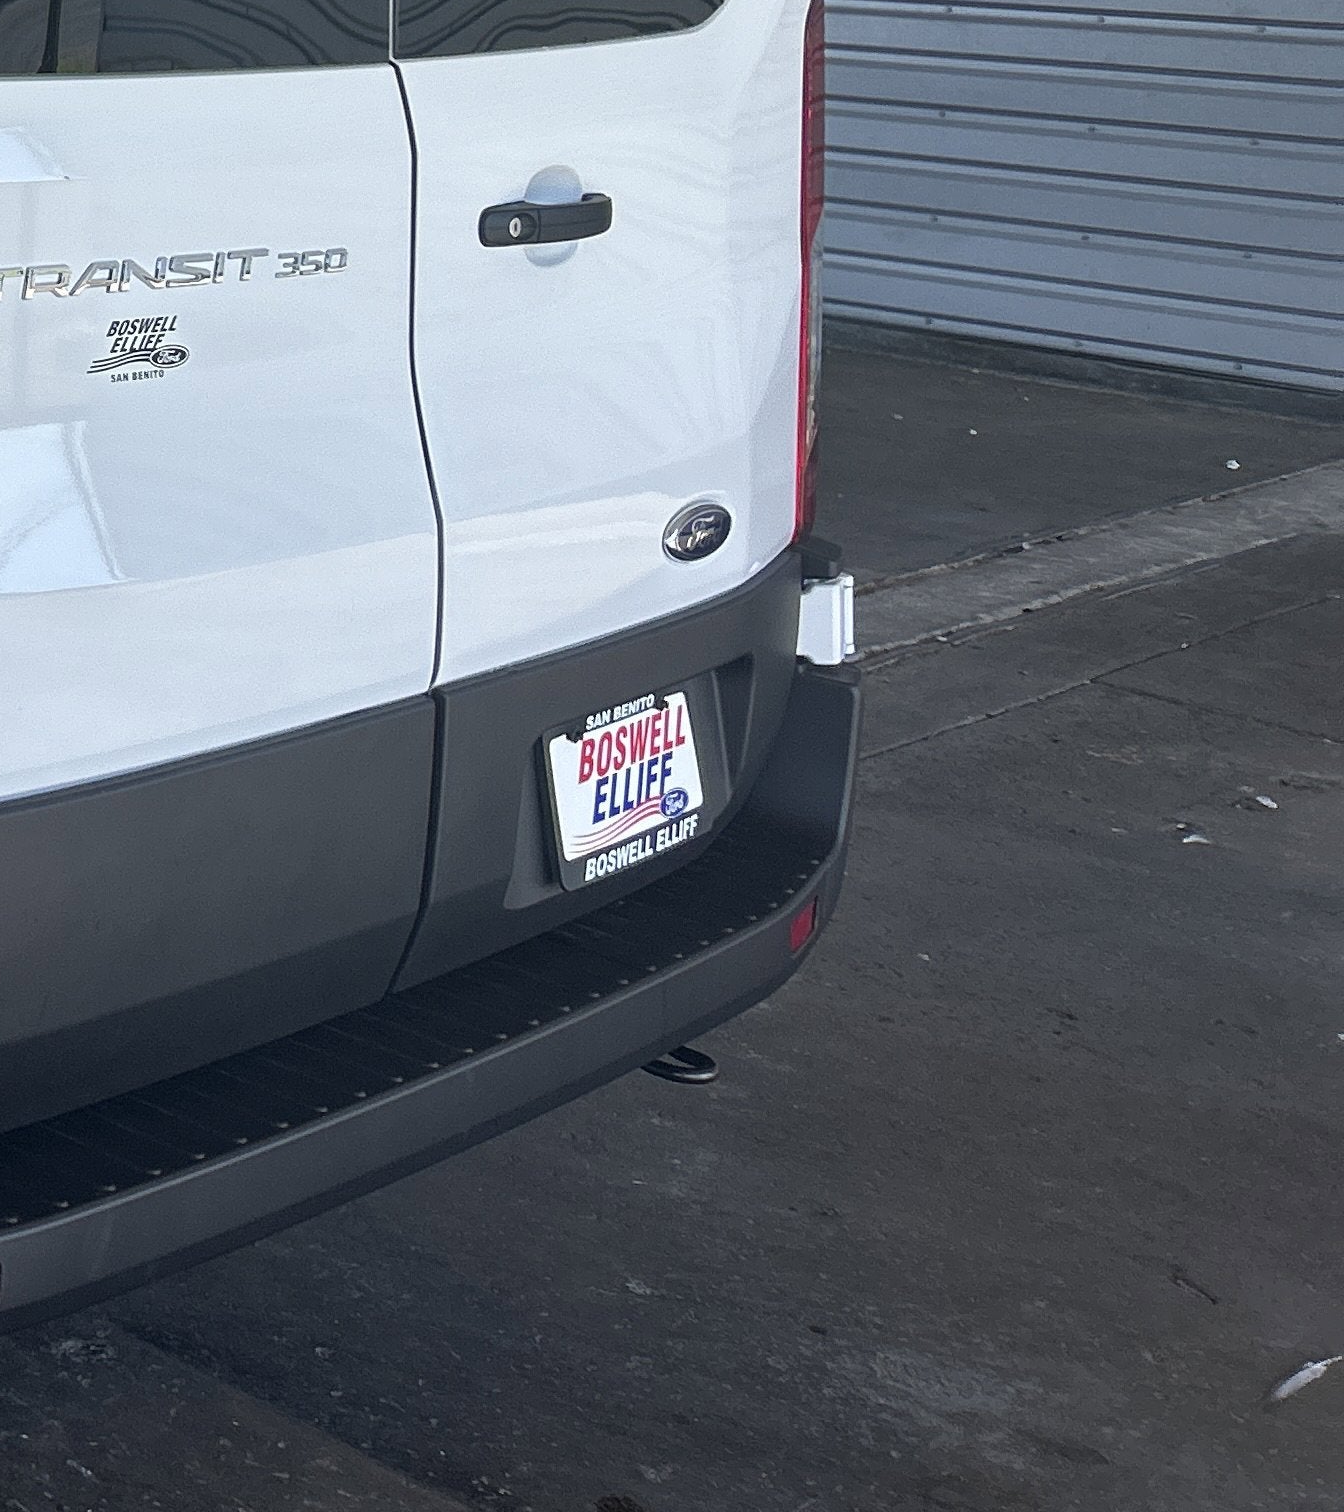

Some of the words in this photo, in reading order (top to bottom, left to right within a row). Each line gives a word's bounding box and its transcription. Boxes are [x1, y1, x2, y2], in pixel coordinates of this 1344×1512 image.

[274, 247, 348, 279] 350
[106, 315, 178, 337] BOSWELL
[110, 333, 166, 354] ELLIFF
[110, 373, 129, 383] SAN
[132, 369, 165, 381] BENITO
[585, 710, 611, 732] SAN
[613, 693, 656, 721] BENITO
[578, 704, 686, 785] BOSWELL
[592, 751, 674, 825] ELLIFF
[584, 834, 654, 882] BOSWELL
[655, 813, 699, 853] ELLIFF
